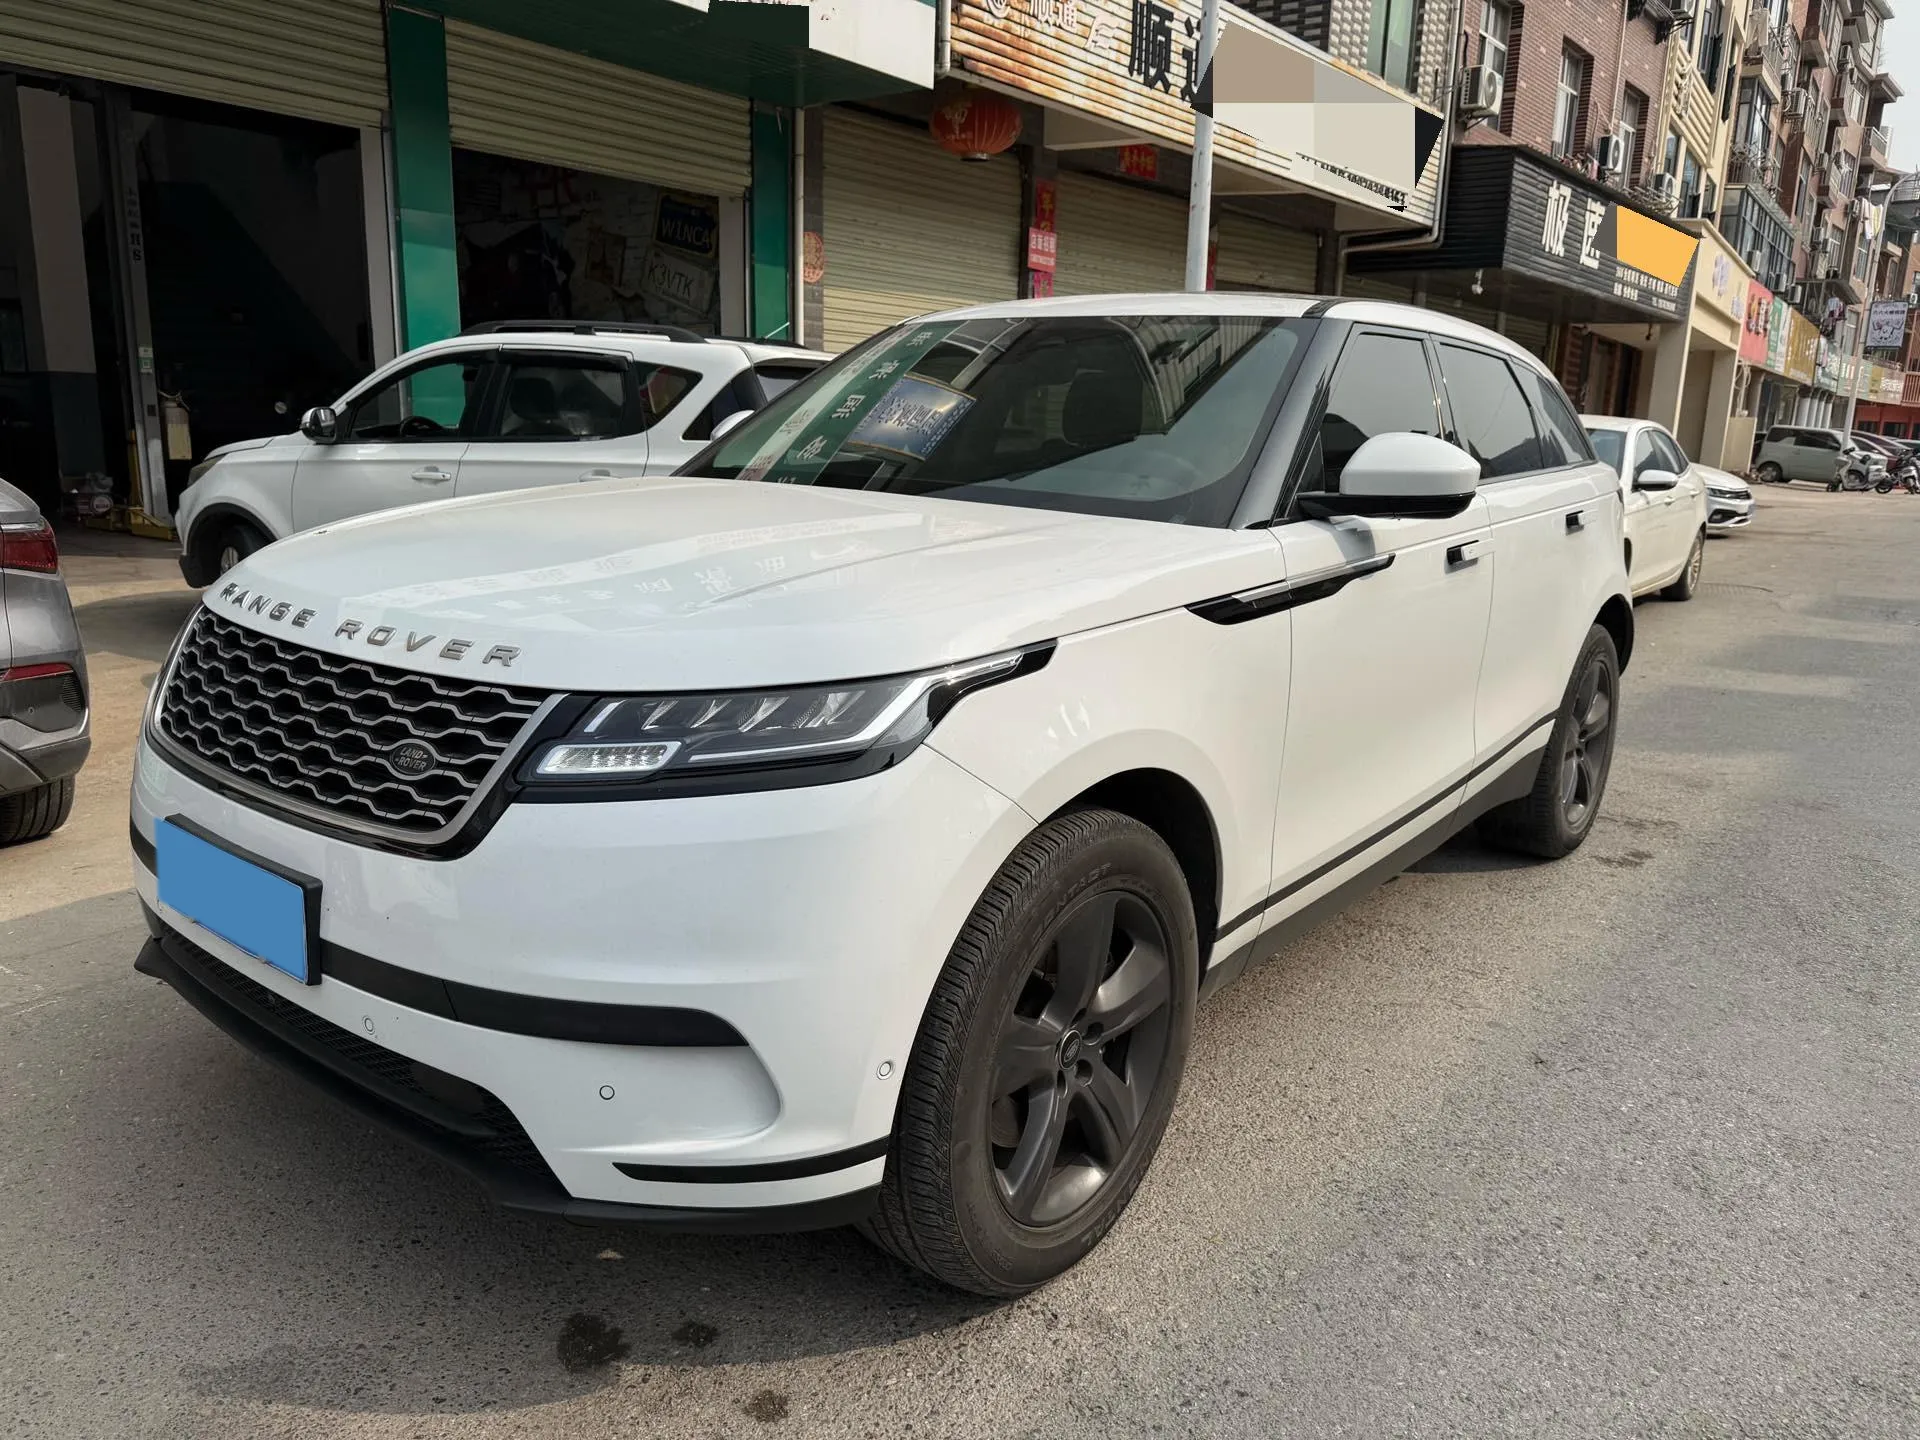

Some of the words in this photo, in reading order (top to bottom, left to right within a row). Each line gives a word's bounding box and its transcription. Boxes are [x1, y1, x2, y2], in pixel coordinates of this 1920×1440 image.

[220, 582, 318, 628] RANGE
[335, 619, 522, 667] ROVER
[400, 747, 424, 759] LAND
[398, 756, 427, 771] ROVER
